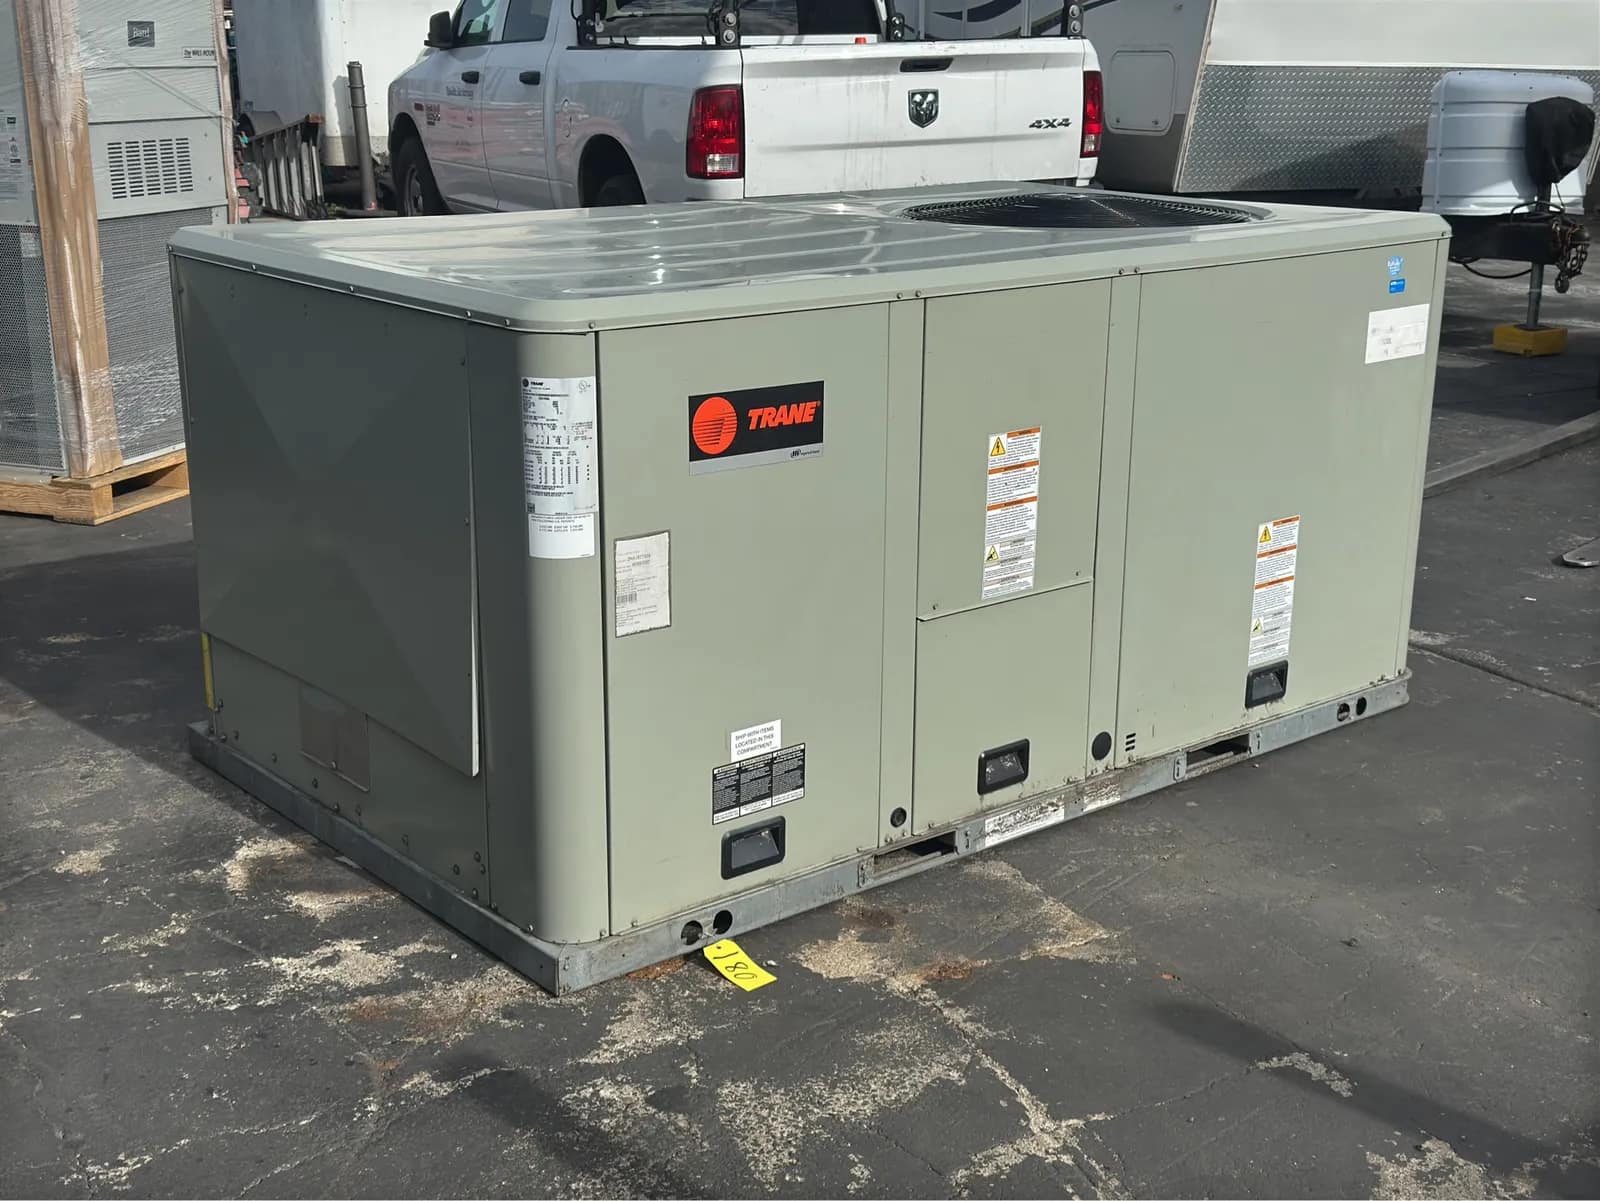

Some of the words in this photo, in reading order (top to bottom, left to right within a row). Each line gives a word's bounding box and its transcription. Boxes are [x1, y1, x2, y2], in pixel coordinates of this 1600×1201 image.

[747, 401, 818, 430] TRANE
[735, 733, 747, 741] SHIP
[747, 730, 759, 738] WITH
[760, 725, 774, 734] ITEMS
[735, 738, 757, 748] LOCATED
[763, 733, 774, 741] THIS
[736, 741, 773, 755] COMPARTMENT
[712, 951, 758, 980] 180
